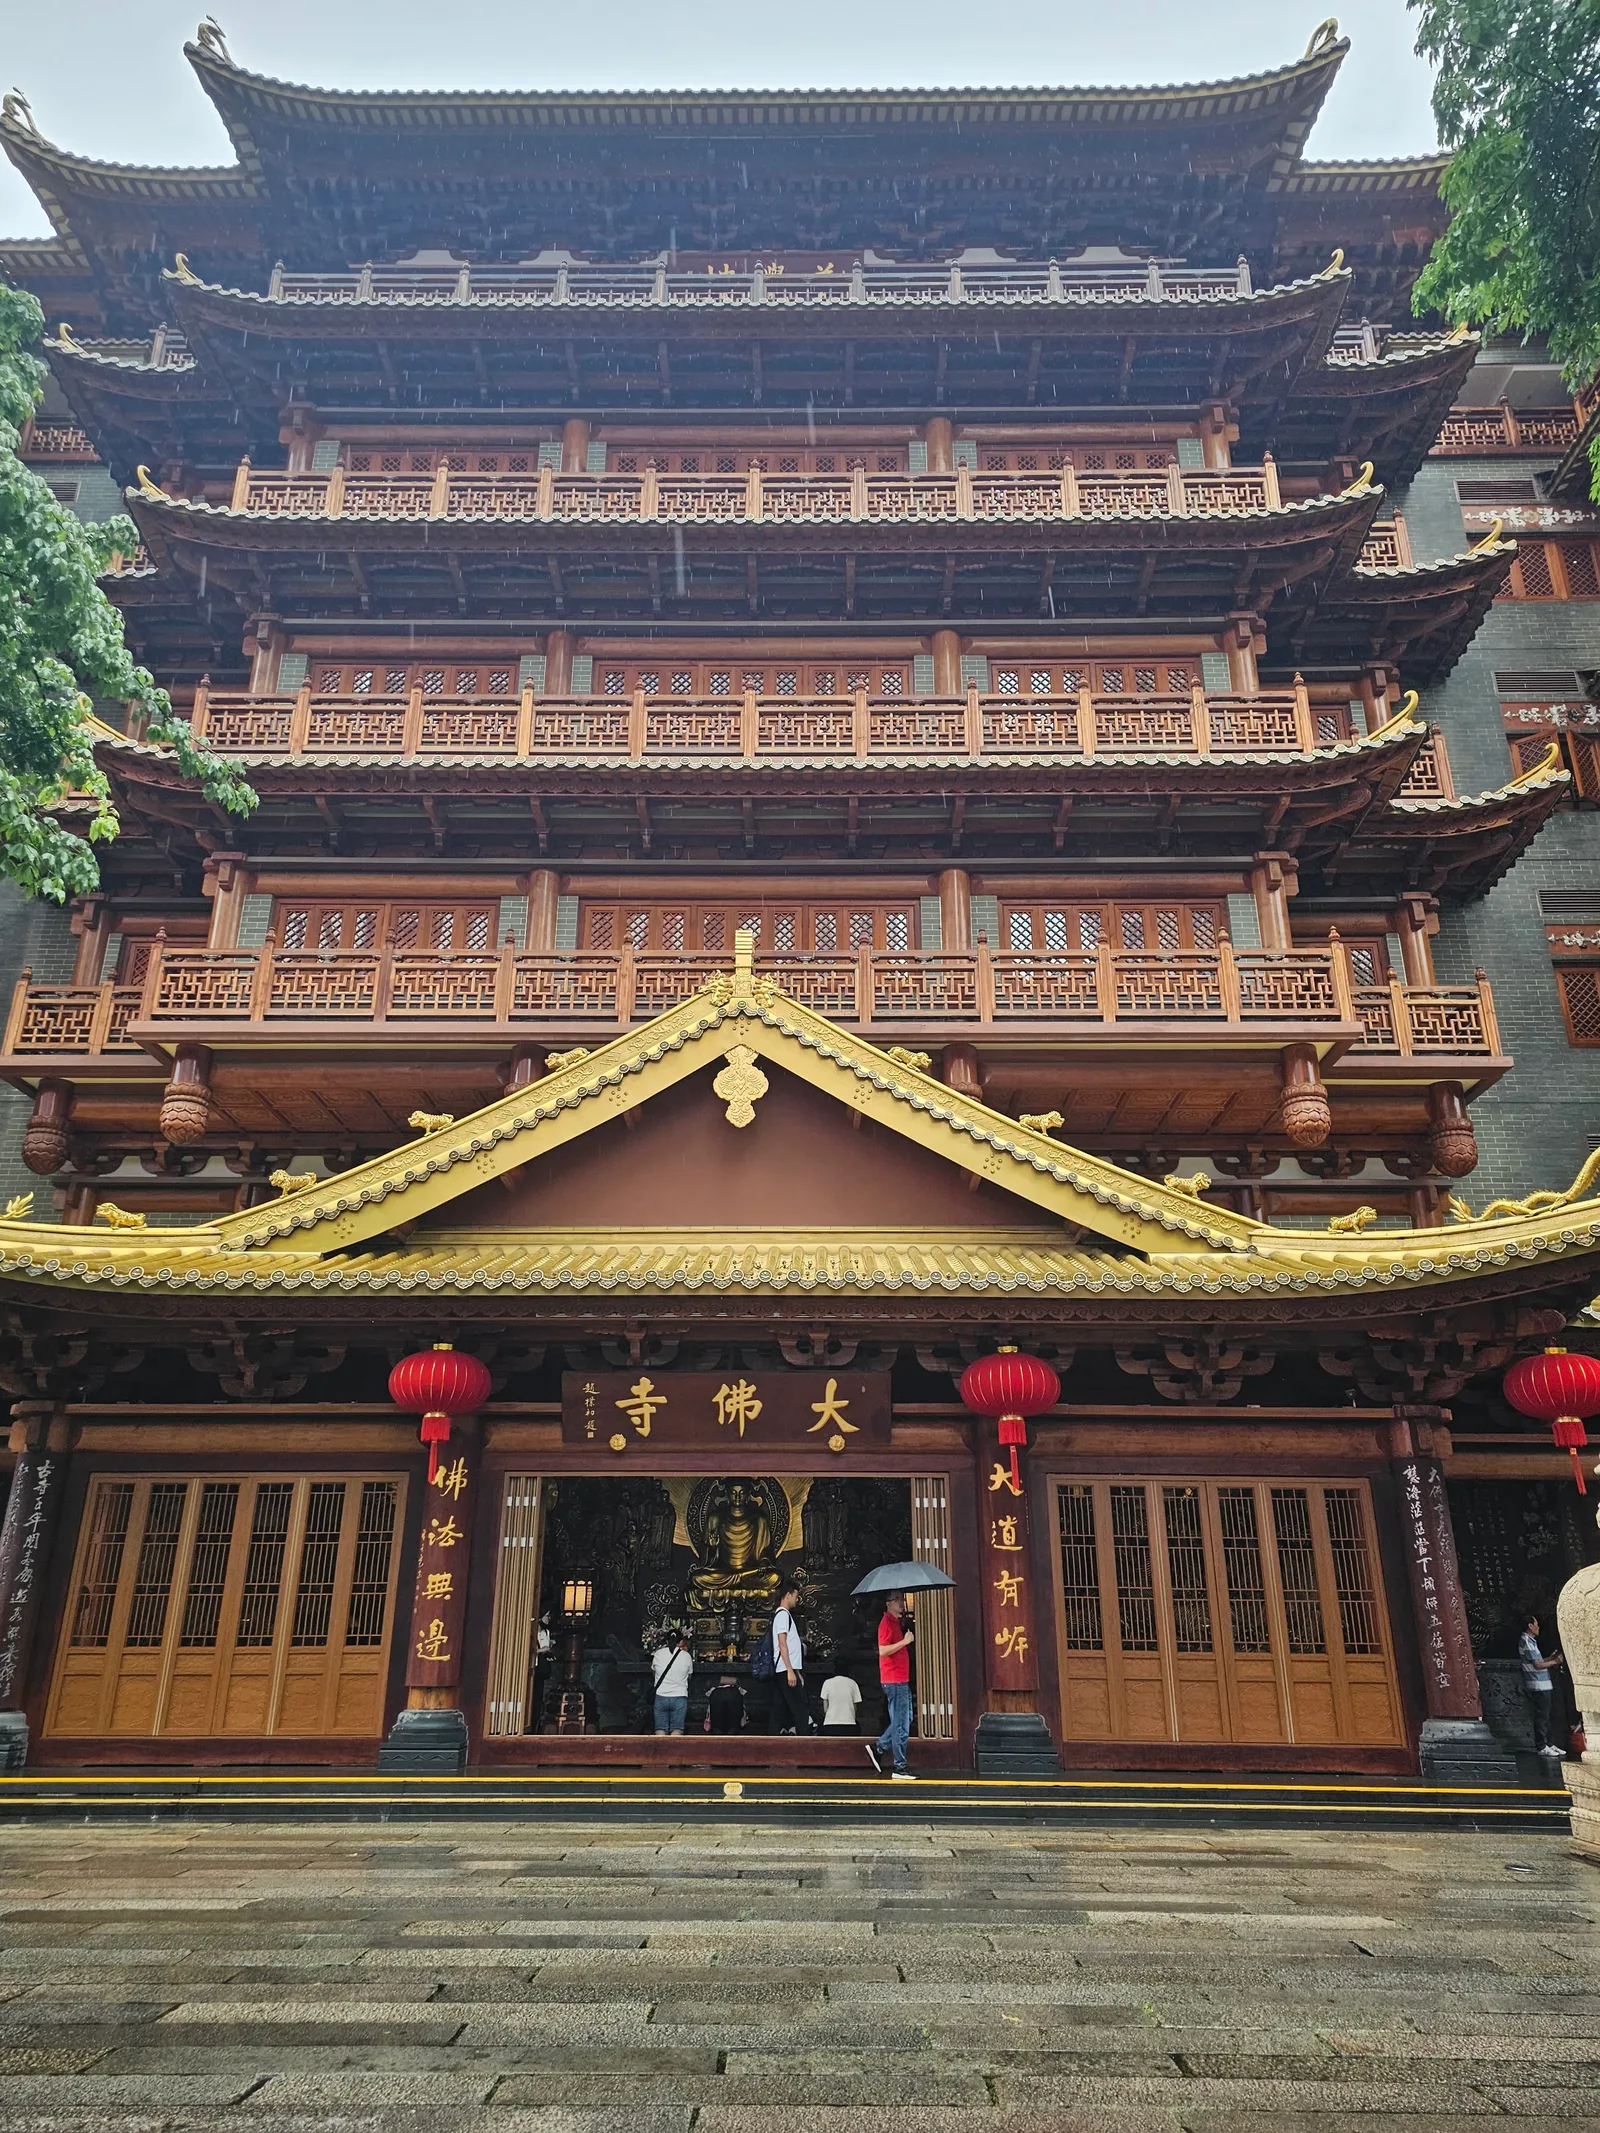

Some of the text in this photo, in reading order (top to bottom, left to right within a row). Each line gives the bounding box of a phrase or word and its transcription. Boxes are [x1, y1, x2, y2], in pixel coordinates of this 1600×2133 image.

[615, 1376, 860, 1437] 大佛寺
[416, 1457, 468, 1661] 佛法無邊
